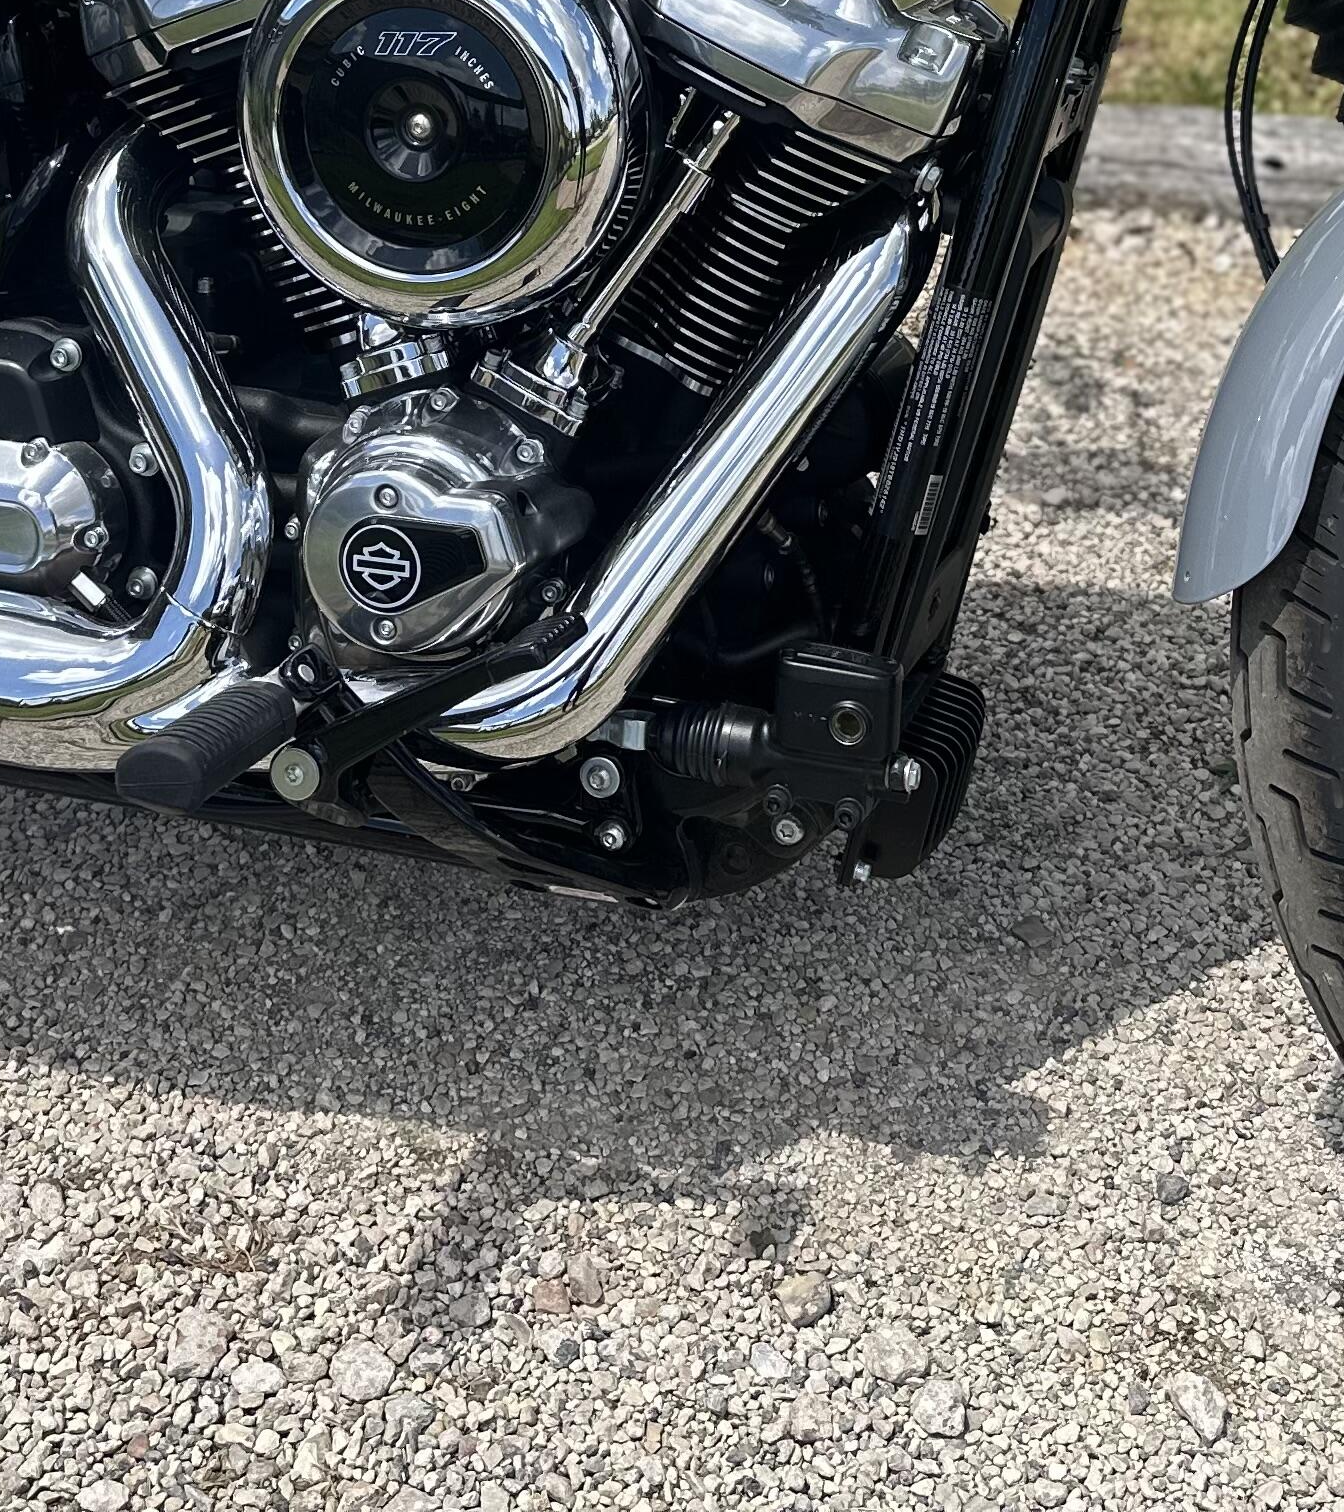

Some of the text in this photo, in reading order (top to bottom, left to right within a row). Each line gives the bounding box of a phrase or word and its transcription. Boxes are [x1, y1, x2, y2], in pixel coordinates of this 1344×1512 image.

[330, 31, 496, 90] CUBIC 117 INCHES
[347, 181, 489, 226] MILWAUKEE-EIGHT
